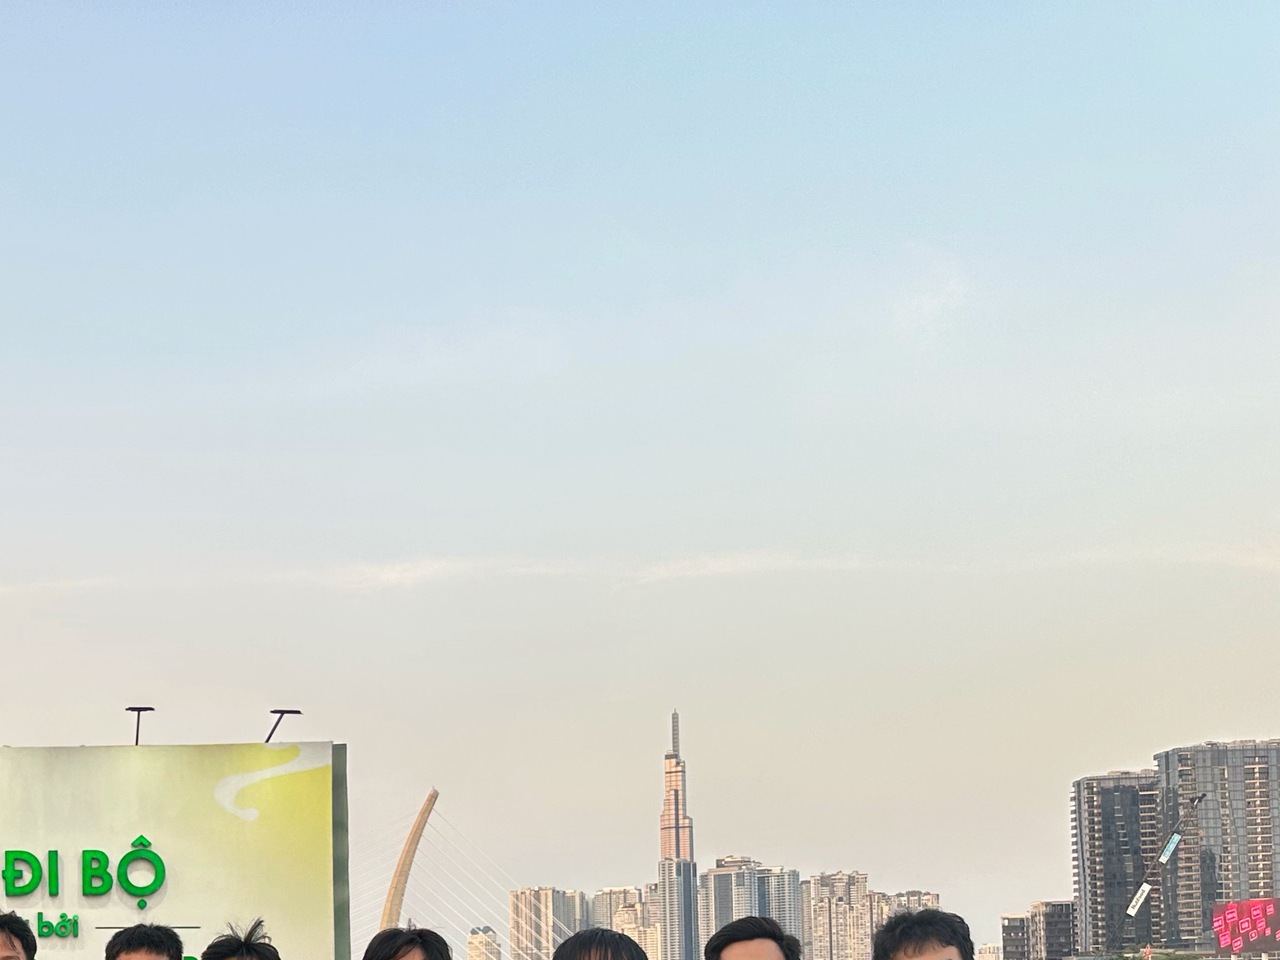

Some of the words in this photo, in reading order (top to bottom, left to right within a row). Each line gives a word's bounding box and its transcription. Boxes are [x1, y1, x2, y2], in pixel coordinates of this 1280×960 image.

[1, 849, 60, 898] ĐI
[81, 834, 166, 910] BỘ
[37, 912, 80, 938] bởi
